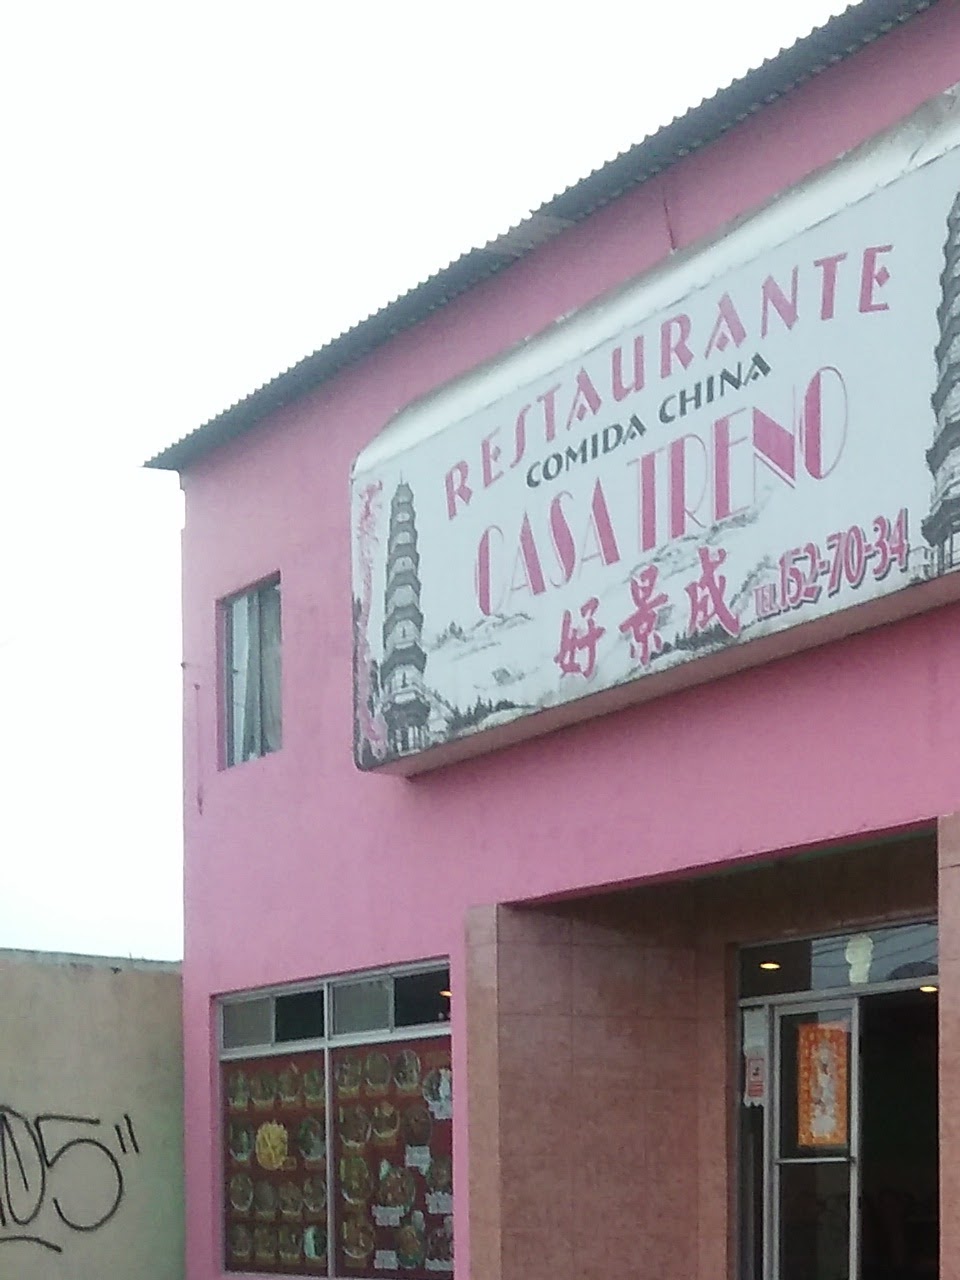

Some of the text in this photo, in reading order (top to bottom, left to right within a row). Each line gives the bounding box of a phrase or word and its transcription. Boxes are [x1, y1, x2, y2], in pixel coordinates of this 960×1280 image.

[444, 244, 894, 520] RESTAURANTE
[474, 364, 848, 617] CASA TRENO
[525, 351, 772, 489] COMIDA CHINA
